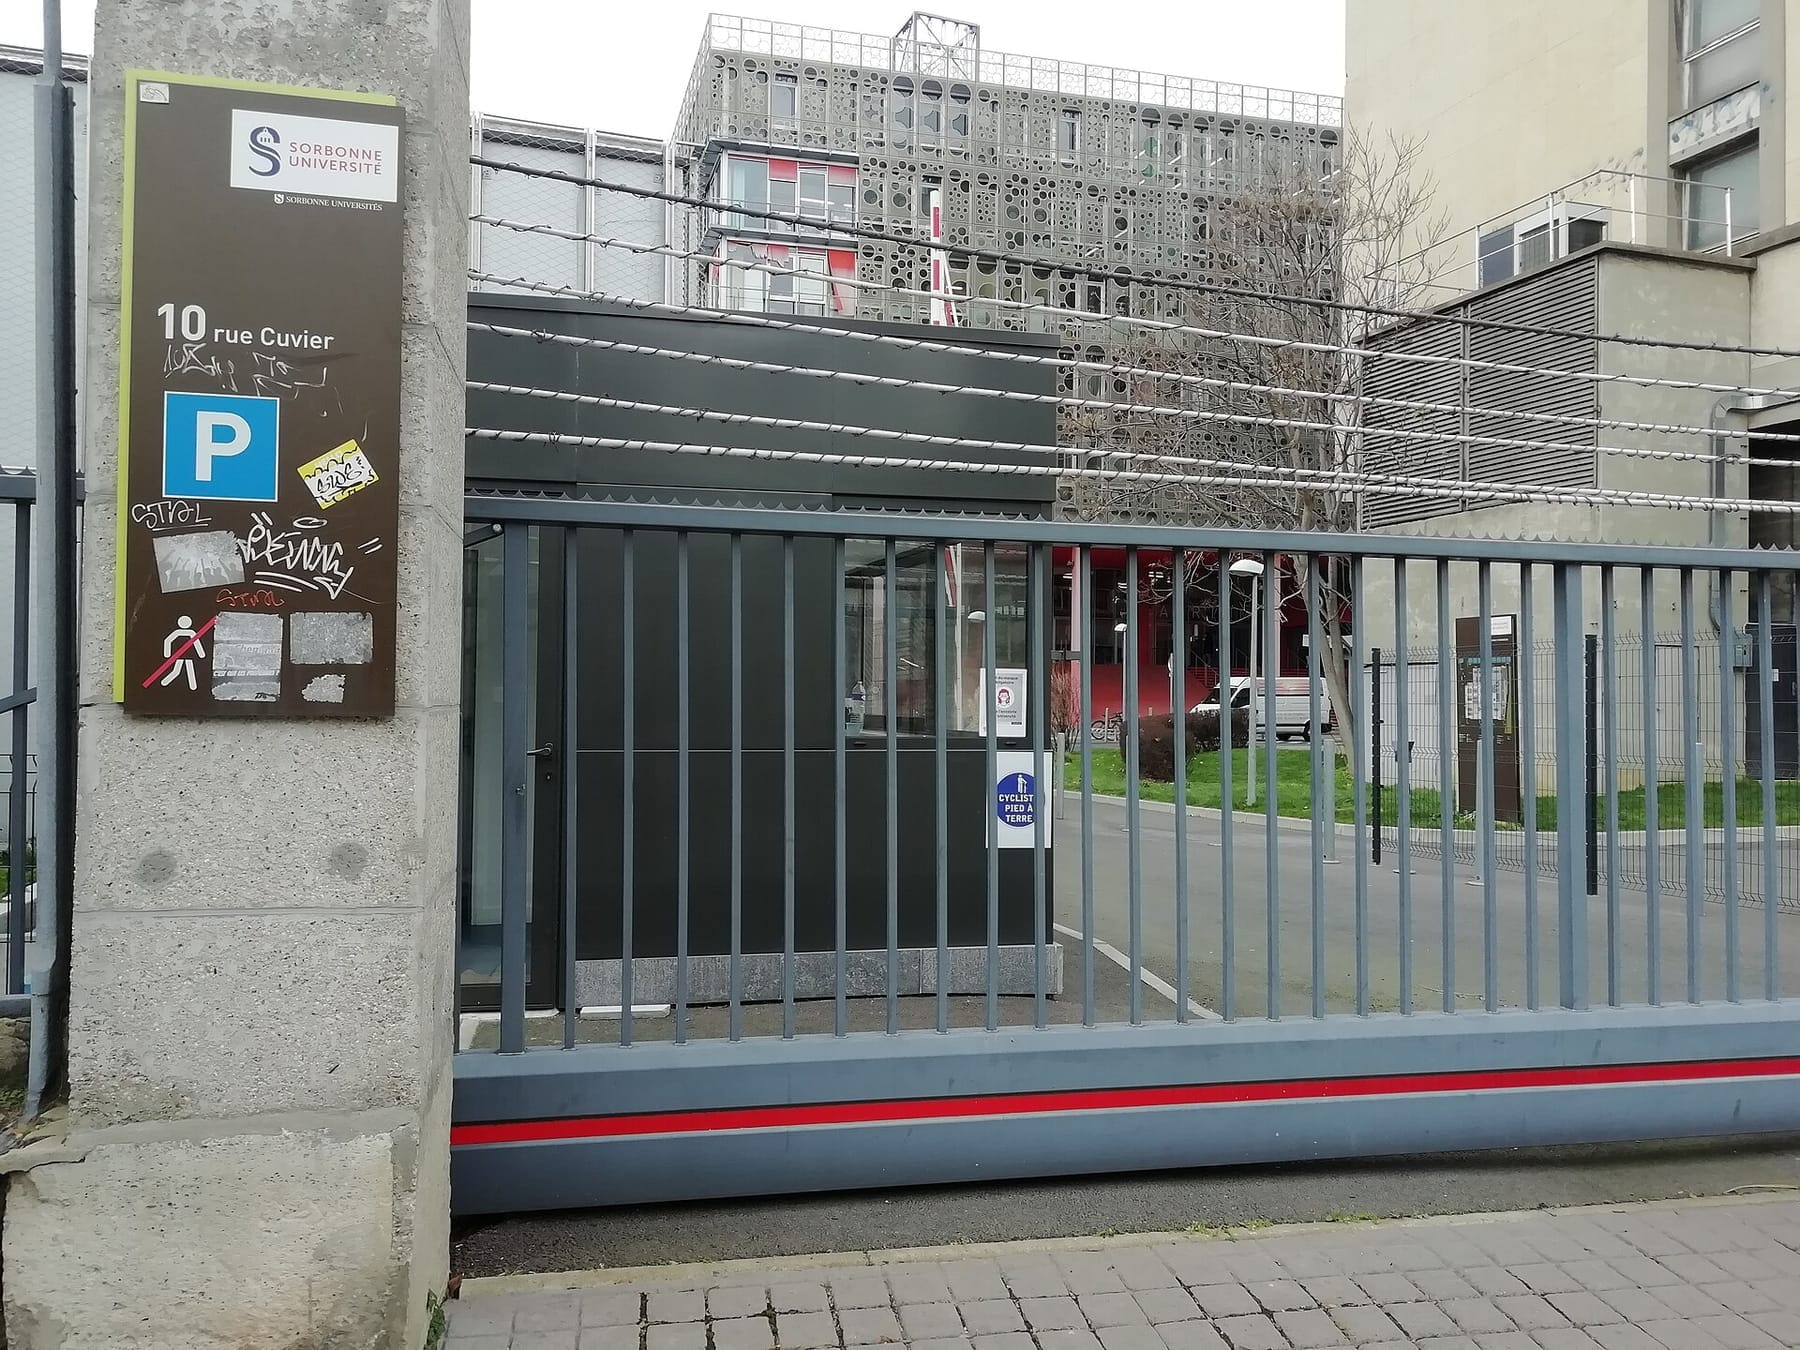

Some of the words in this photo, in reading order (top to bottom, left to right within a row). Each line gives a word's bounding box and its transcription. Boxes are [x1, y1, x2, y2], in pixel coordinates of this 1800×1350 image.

[289, 142, 382, 161] SORBONNE
[289, 155, 382, 175] UNIVERSITÉ
[286, 195, 330, 207] SORBONNE
[331, 199, 383, 211] UNIVERSITÉS
[157, 303, 206, 341] 10
[213, 328, 253, 344] rue
[260, 327, 335, 350] Cuvier
[195, 411, 251, 482] P
[998, 793, 1034, 803] CYCLIST
[1004, 804, 1025, 813] PIED
[1027, 802, 1034, 813] À
[1005, 814, 1033, 823] TERRE
